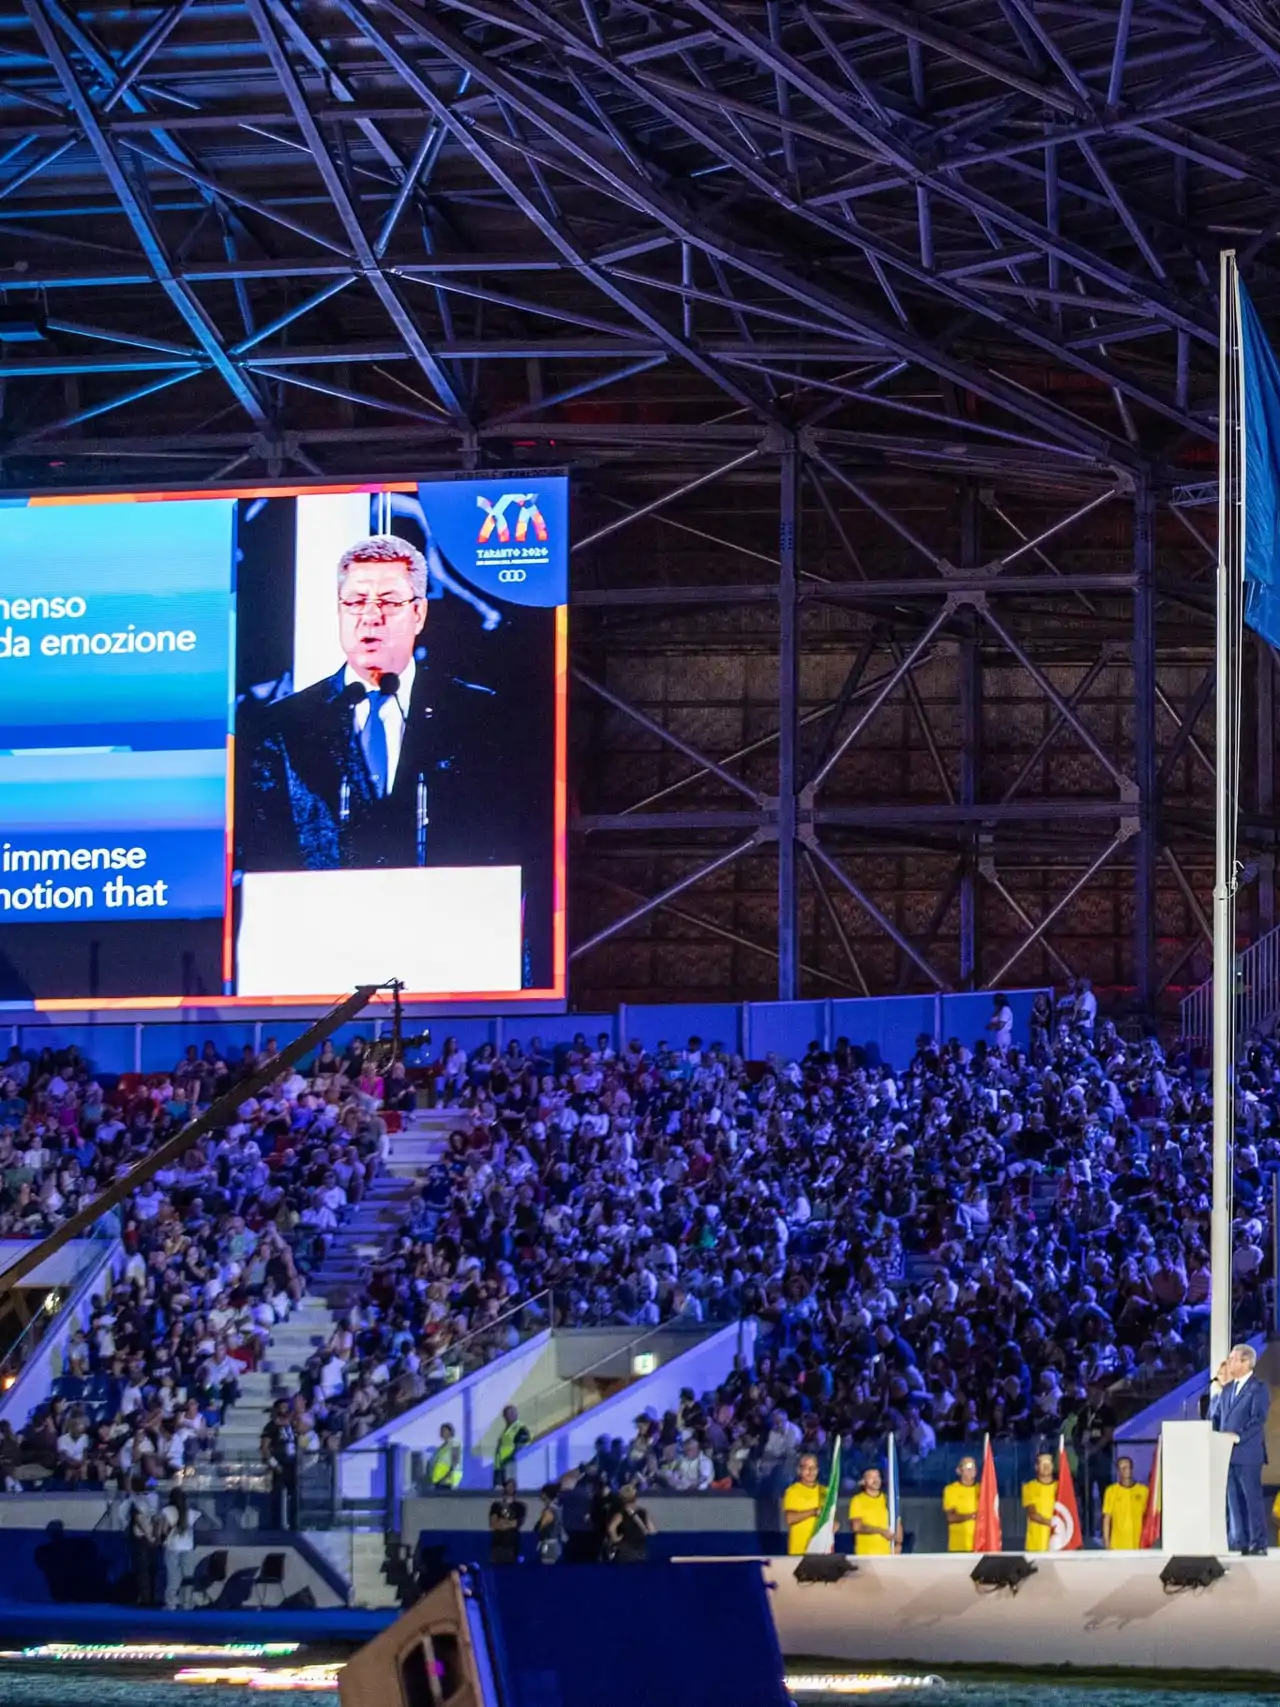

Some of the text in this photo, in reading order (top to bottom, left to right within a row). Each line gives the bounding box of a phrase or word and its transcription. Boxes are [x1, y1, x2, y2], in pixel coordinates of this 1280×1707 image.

[476, 547, 549, 559] TARANTO 2026
[40, 624, 197, 657] emozione
[3, 843, 148, 873] immense
[102, 875, 169, 909] that
